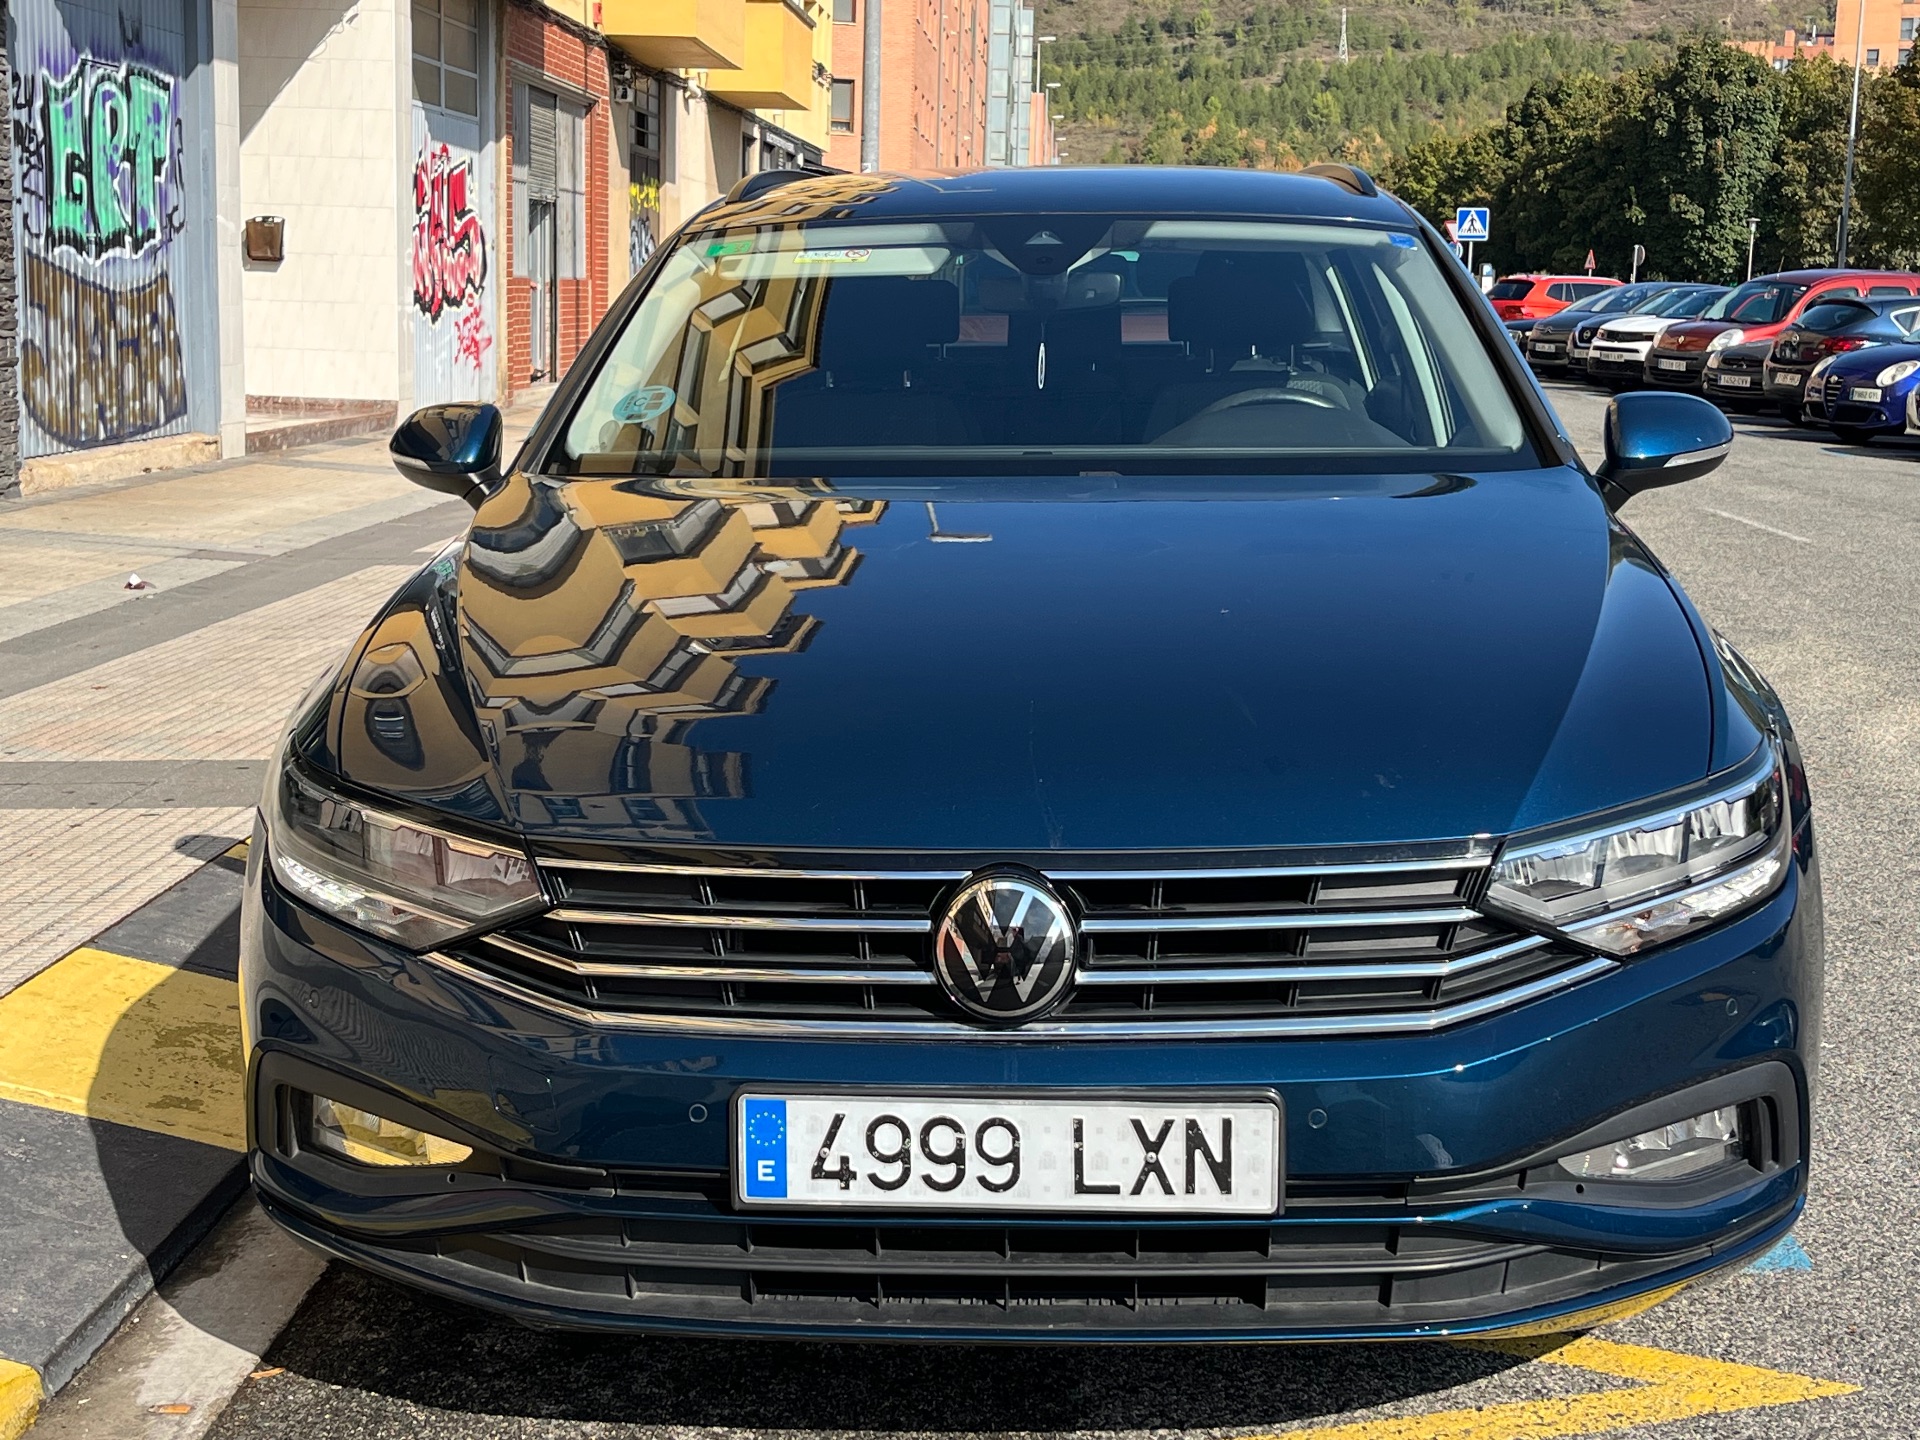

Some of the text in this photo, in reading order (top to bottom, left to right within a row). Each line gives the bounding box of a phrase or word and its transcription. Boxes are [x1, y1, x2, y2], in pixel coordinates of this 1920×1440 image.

[757, 1160, 775, 1181] E
[811, 1113, 1233, 1196] 4999 LXN
